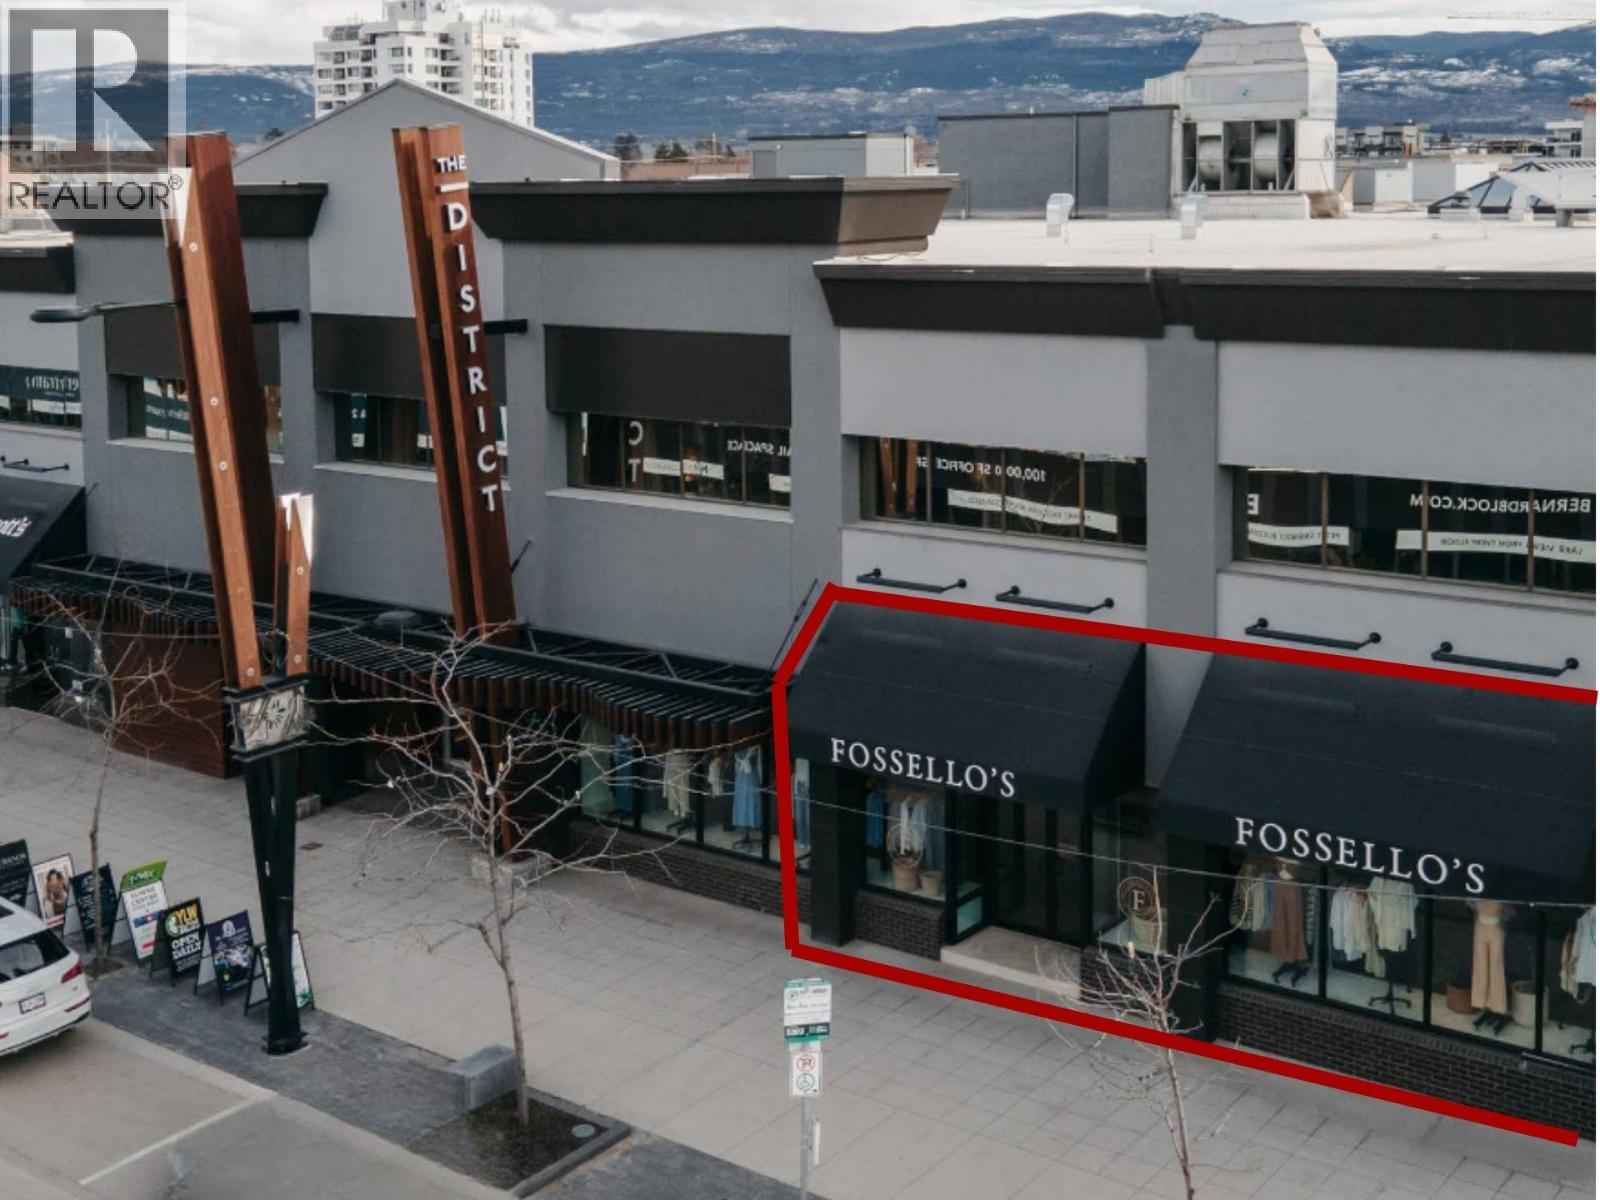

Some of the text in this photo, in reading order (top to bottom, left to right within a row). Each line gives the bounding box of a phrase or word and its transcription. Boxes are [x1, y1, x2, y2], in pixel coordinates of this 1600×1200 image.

[437, 155, 467, 173] THE
[447, 202, 498, 512] DISTRICT
[831, 737, 1015, 798] FOSSELLO'S
[1235, 817, 1485, 894] FOSSELLO'S
[176, 904, 198, 924] YLW
[171, 932, 200, 949] OPEN
